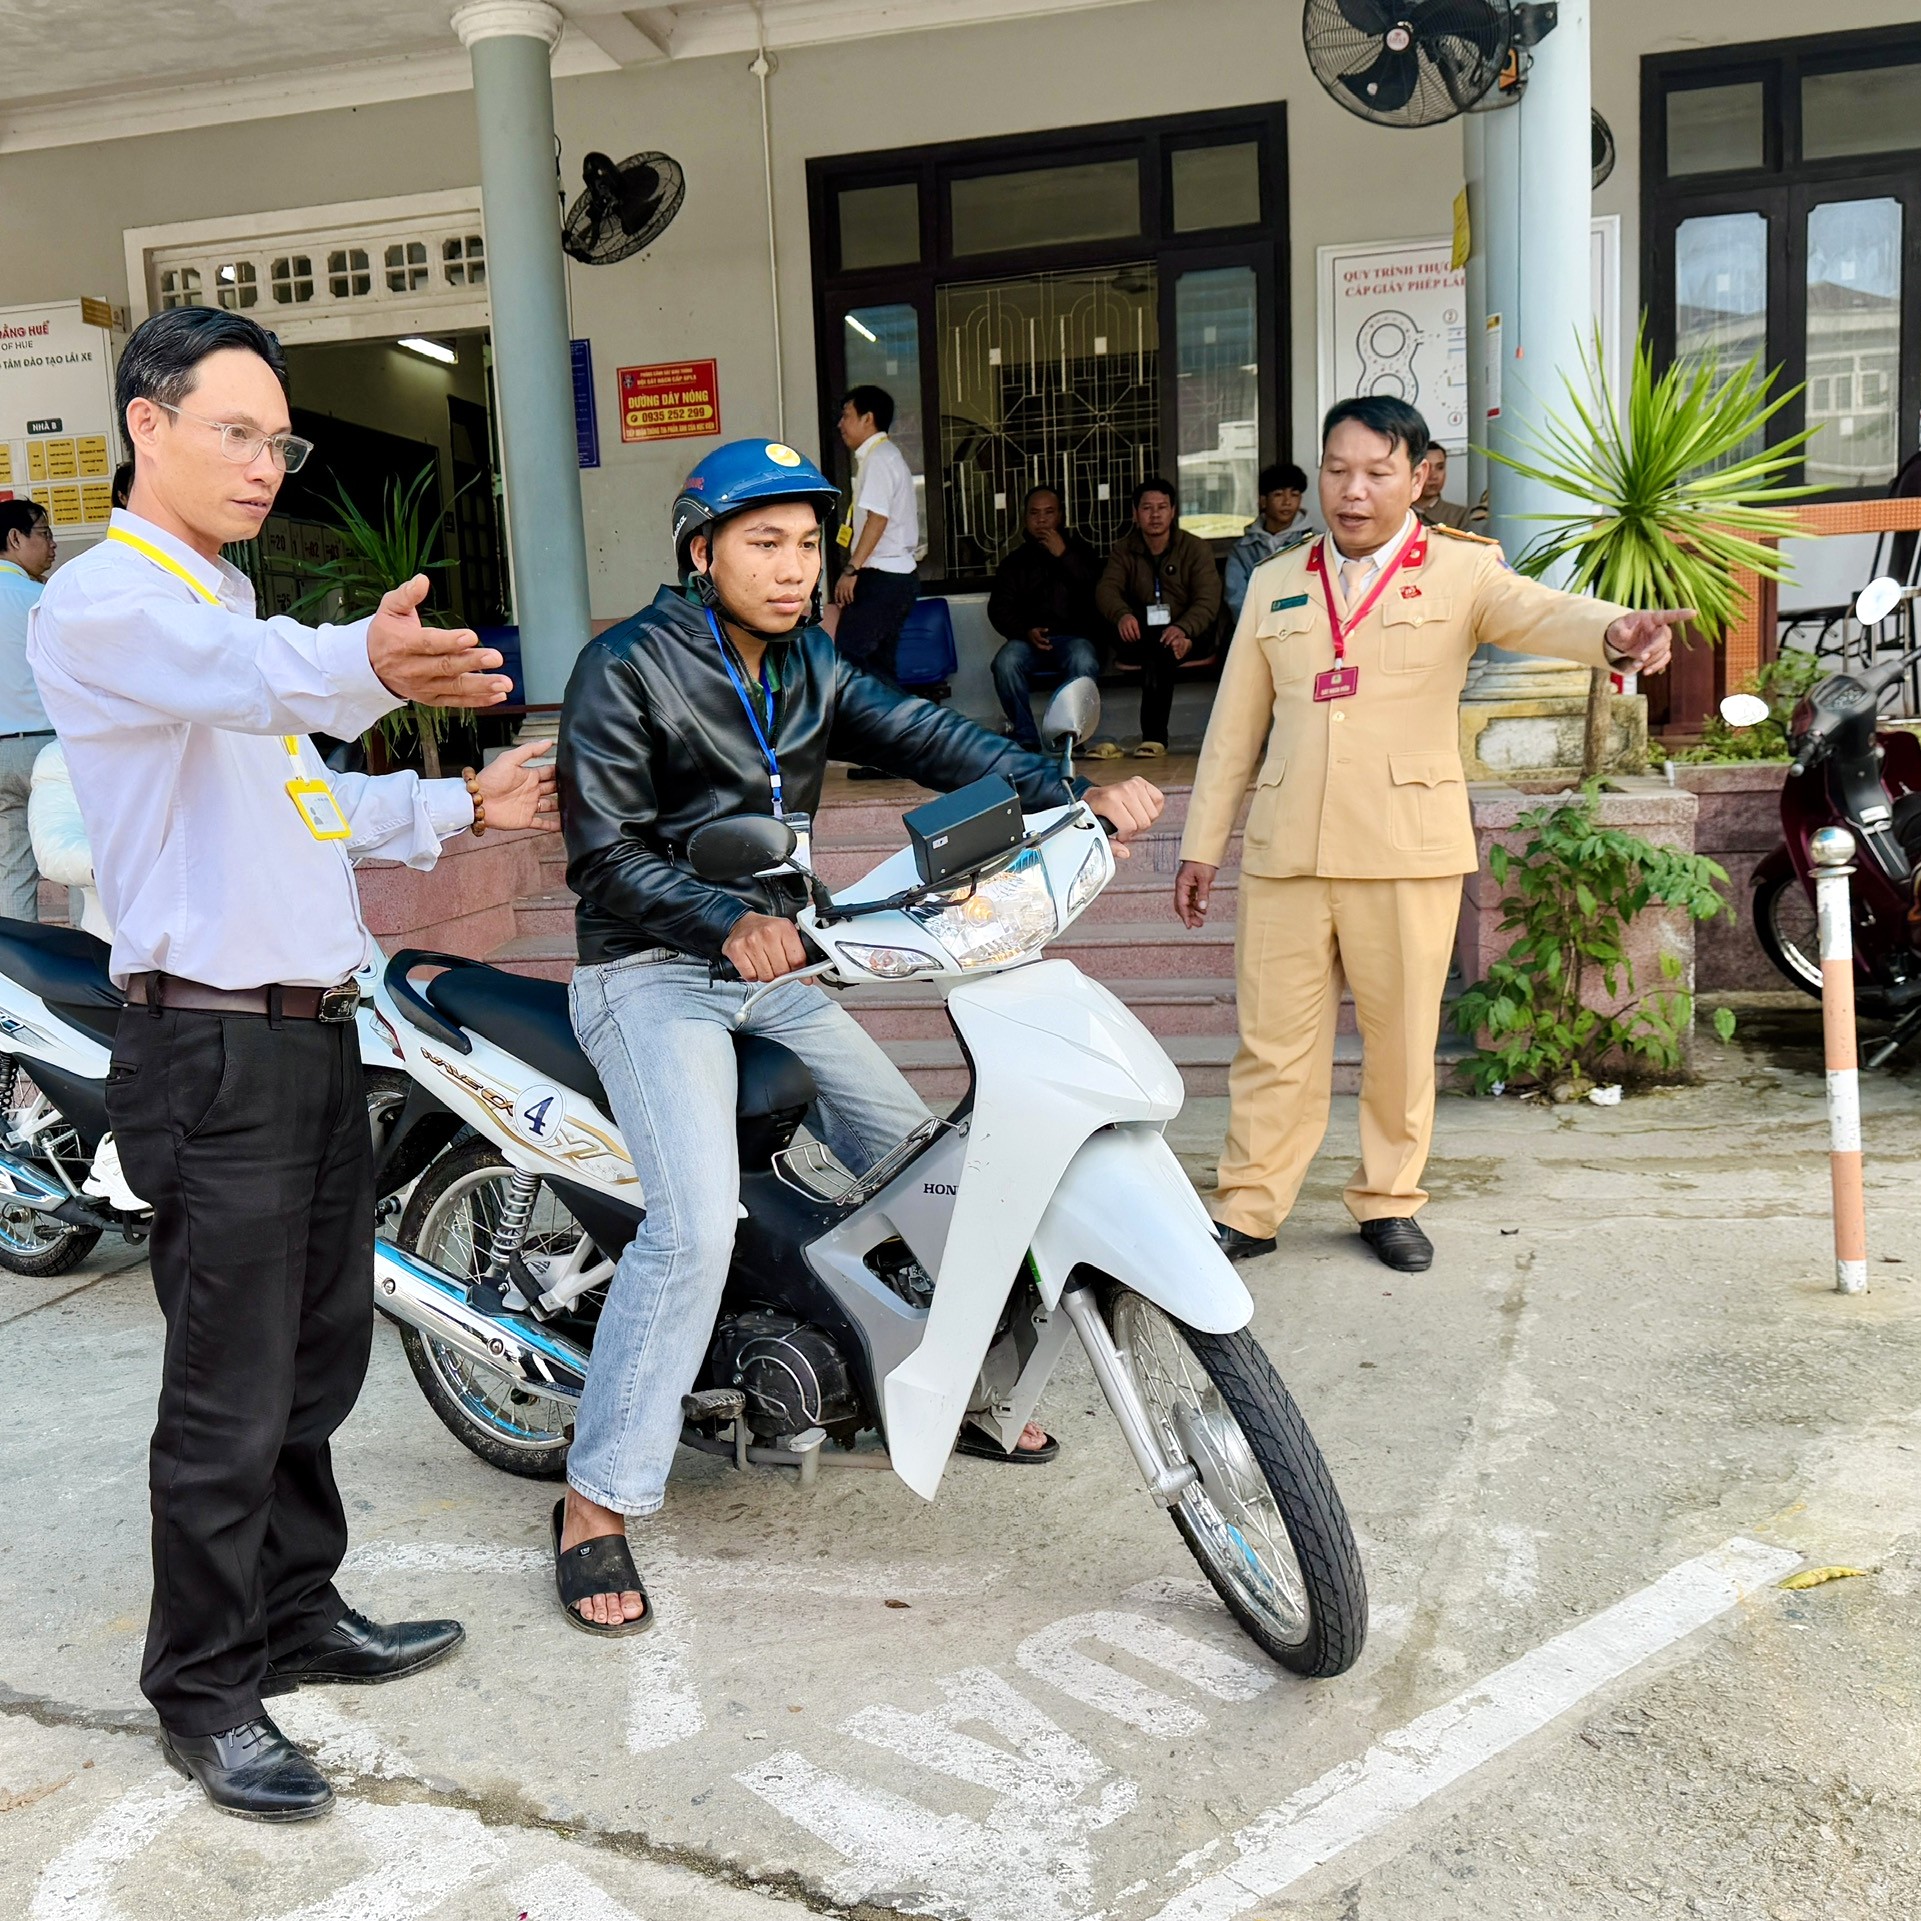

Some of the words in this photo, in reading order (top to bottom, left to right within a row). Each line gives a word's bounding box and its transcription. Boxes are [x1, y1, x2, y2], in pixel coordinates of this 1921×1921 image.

[1343, 269, 1370, 282] QUY
[1374, 264, 1413, 278] TRÌNH
[1345, 283, 1370, 297] CẤP
[1372, 280, 1404, 294] GIẤY
[1408, 276, 1441, 291] PHÉP
[28, 320, 49, 336] HUẾ
[1, 342, 13, 351] OF
[15, 340, 33, 350] HUE
[3, 358, 21, 369] TÂM
[24, 356, 43, 367] ĐÀO
[45, 354, 63, 367] TẠO
[65, 351, 79, 363] LÁI
[81, 351, 93, 362] XE
[628, 393, 660, 409] ĐƯỜNG
[662, 391, 680, 405] DÂY
[682, 389, 709, 404] NÓNG
[641, 411, 665, 423] 0935
[667, 409, 685, 419] 252
[687, 407, 705, 418] 299
[32, 421, 50, 431] NHÀ
[420, 1046, 484, 1090] WAVE
[523, 1096, 555, 1137] 4
[923, 1183, 959, 1196] HON
